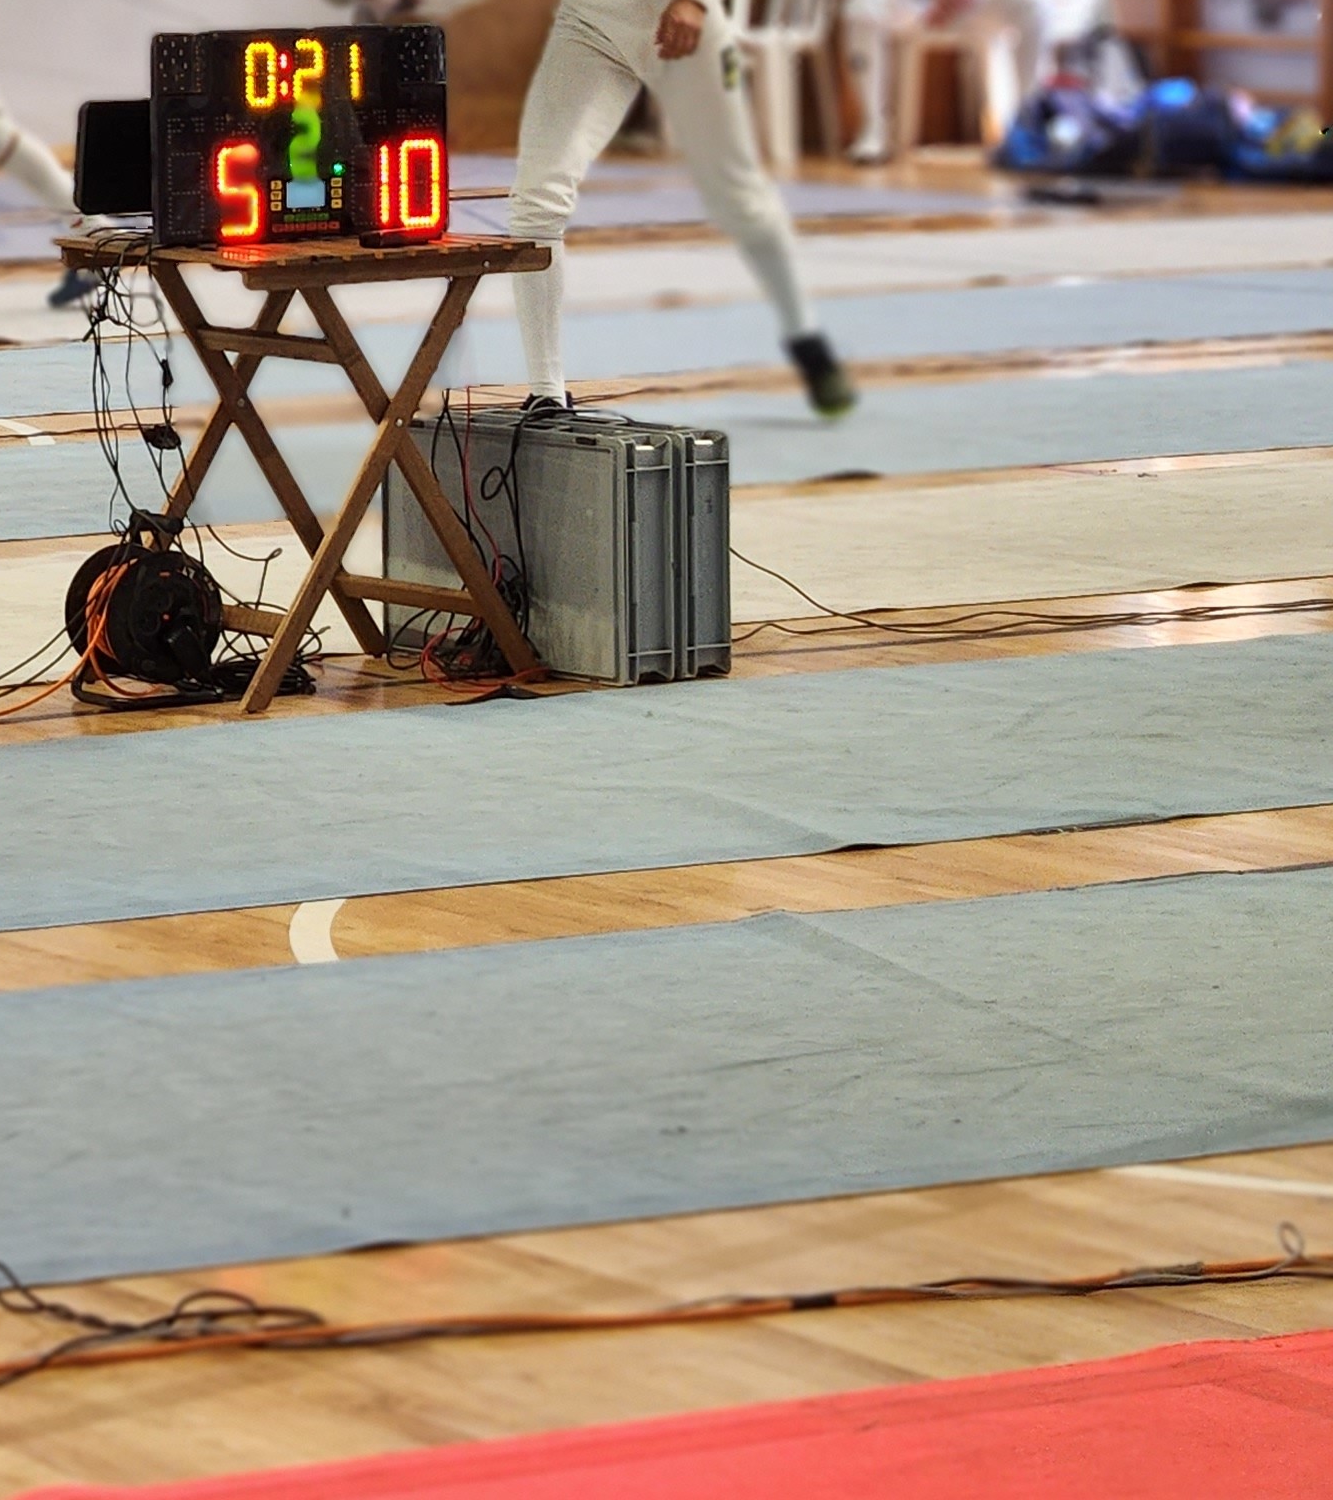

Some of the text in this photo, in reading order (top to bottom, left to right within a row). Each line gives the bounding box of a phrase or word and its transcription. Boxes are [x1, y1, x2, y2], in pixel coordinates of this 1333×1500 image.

[244, 38, 362, 108] 0:21
[289, 102, 322, 181] 2
[379, 138, 441, 228] 10
[217, 142, 260, 237] 5
